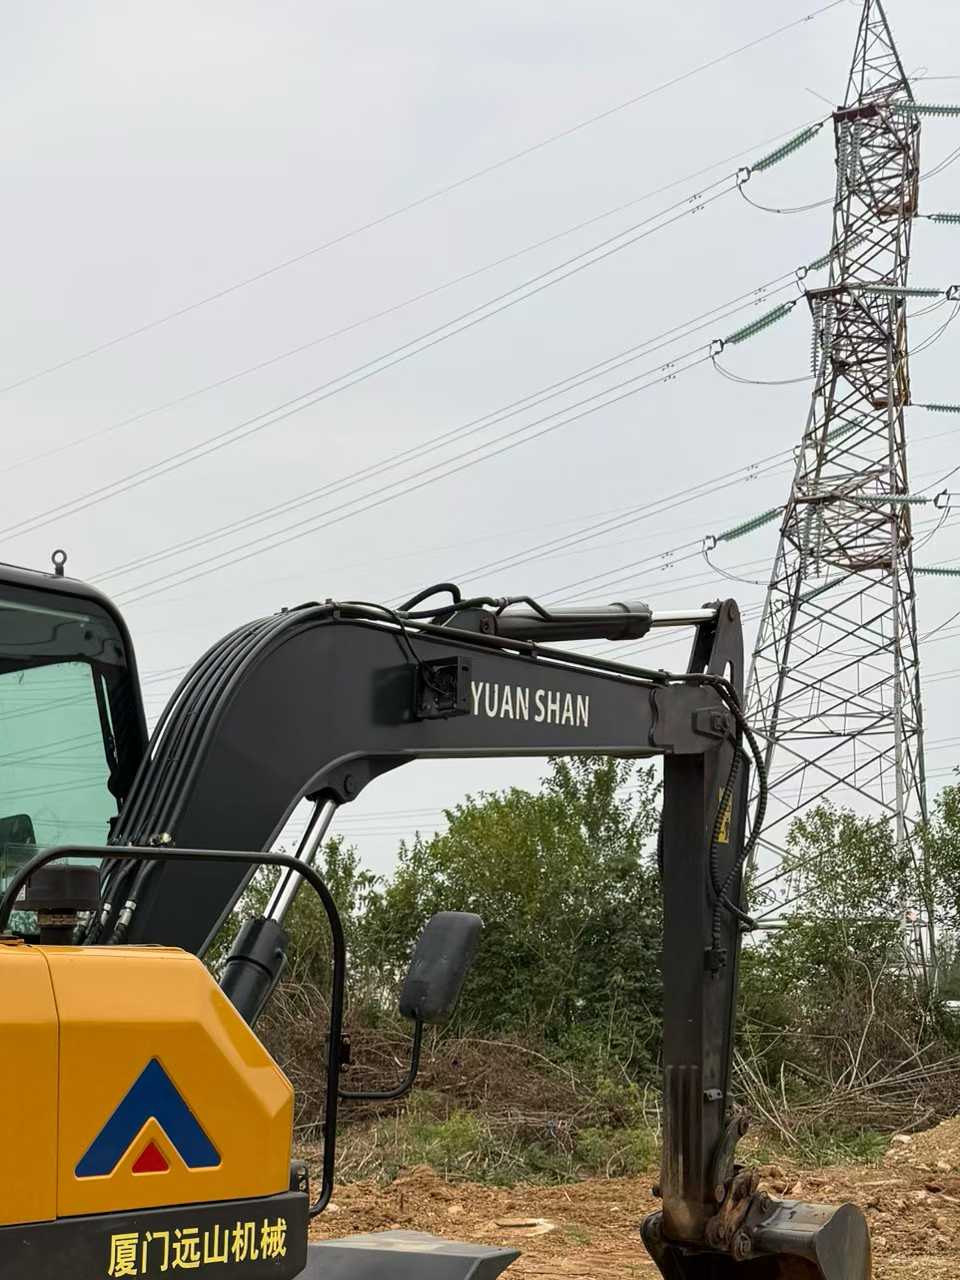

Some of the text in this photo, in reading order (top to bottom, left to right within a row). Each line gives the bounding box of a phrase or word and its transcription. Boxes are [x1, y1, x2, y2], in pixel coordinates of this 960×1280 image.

[471, 681, 590, 727] YUAN SHAN
[107, 1217, 288, 1278] 厦门远山机械
